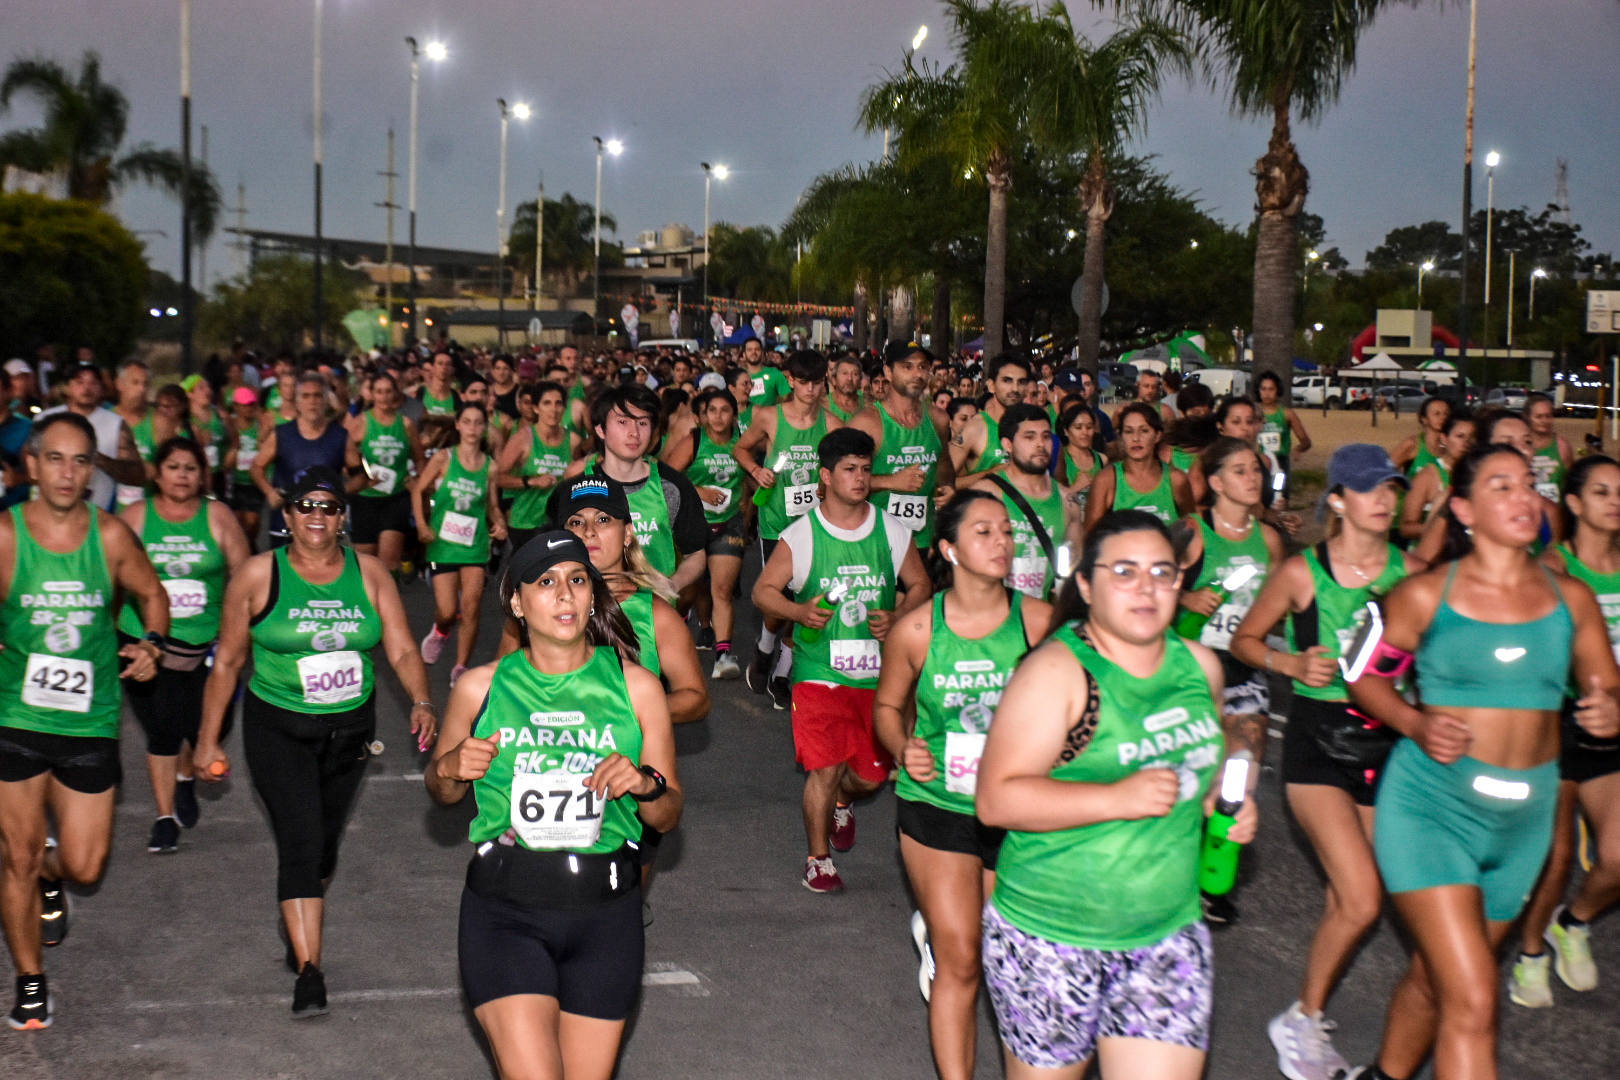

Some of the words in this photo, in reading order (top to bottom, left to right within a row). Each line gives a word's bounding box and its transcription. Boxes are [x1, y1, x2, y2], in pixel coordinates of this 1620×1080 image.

[704, 458, 737, 467] PARAN
[778, 451, 820, 461] PARAN
[886, 450, 937, 464] PARANÁ
[571, 479, 608, 492] PARANÁ
[793, 490, 813, 505] 55
[890, 502, 925, 519] 183
[631, 518, 659, 532] ANÁ
[20, 590, 104, 607] PARANÁ
[169, 593, 204, 607] 002
[288, 605, 366, 619] PARANÁ
[1208, 612, 1240, 634] 46
[834, 655, 880, 671] 5141
[31, 666, 88, 694] 422
[306, 667, 360, 692] 5001
[498, 724, 617, 750] PARANÁ
[1117, 711, 1221, 766] PARANÁ
[518, 790, 600, 823] 671
